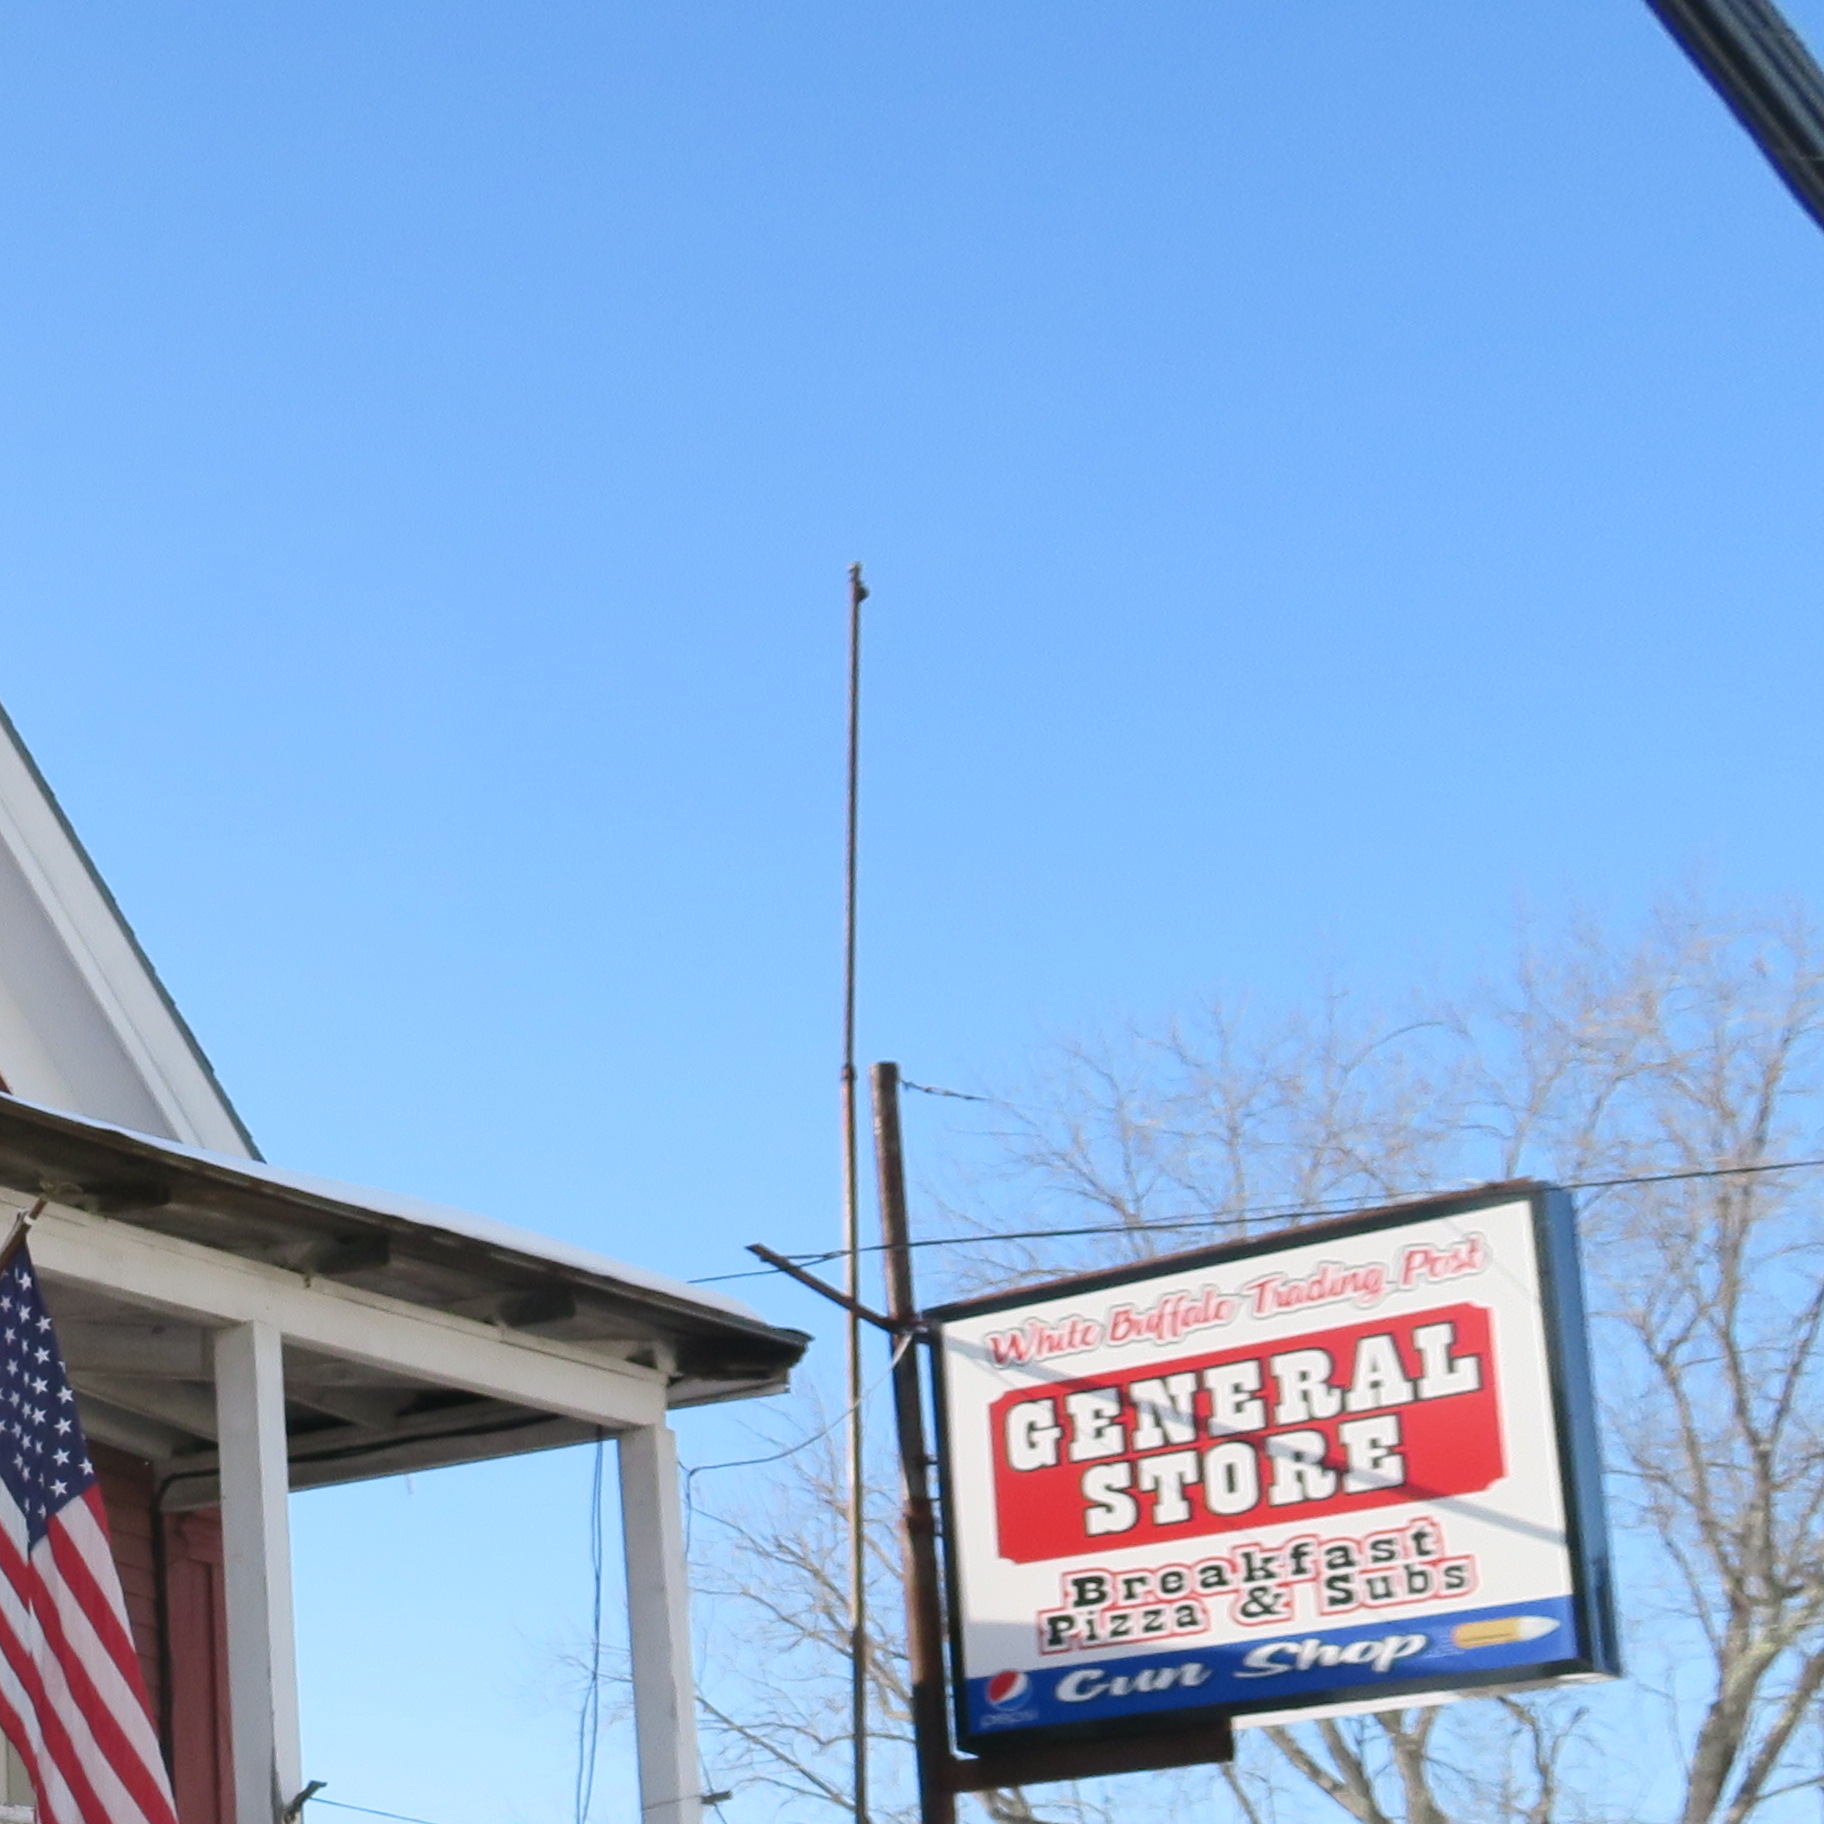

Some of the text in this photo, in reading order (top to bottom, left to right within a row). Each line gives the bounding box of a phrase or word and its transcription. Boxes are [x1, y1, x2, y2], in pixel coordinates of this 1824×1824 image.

[989, 1234, 1487, 1369] White Buffalo Trading Post
[1004, 1321, 1480, 1474] GENERAL
[1080, 1413, 1408, 1538] STORE
[1046, 1558, 1470, 1649] Pizza & Subs
[1071, 1529, 1436, 1609] Breakfast
[1055, 1633, 1426, 1703] Gun Shop
